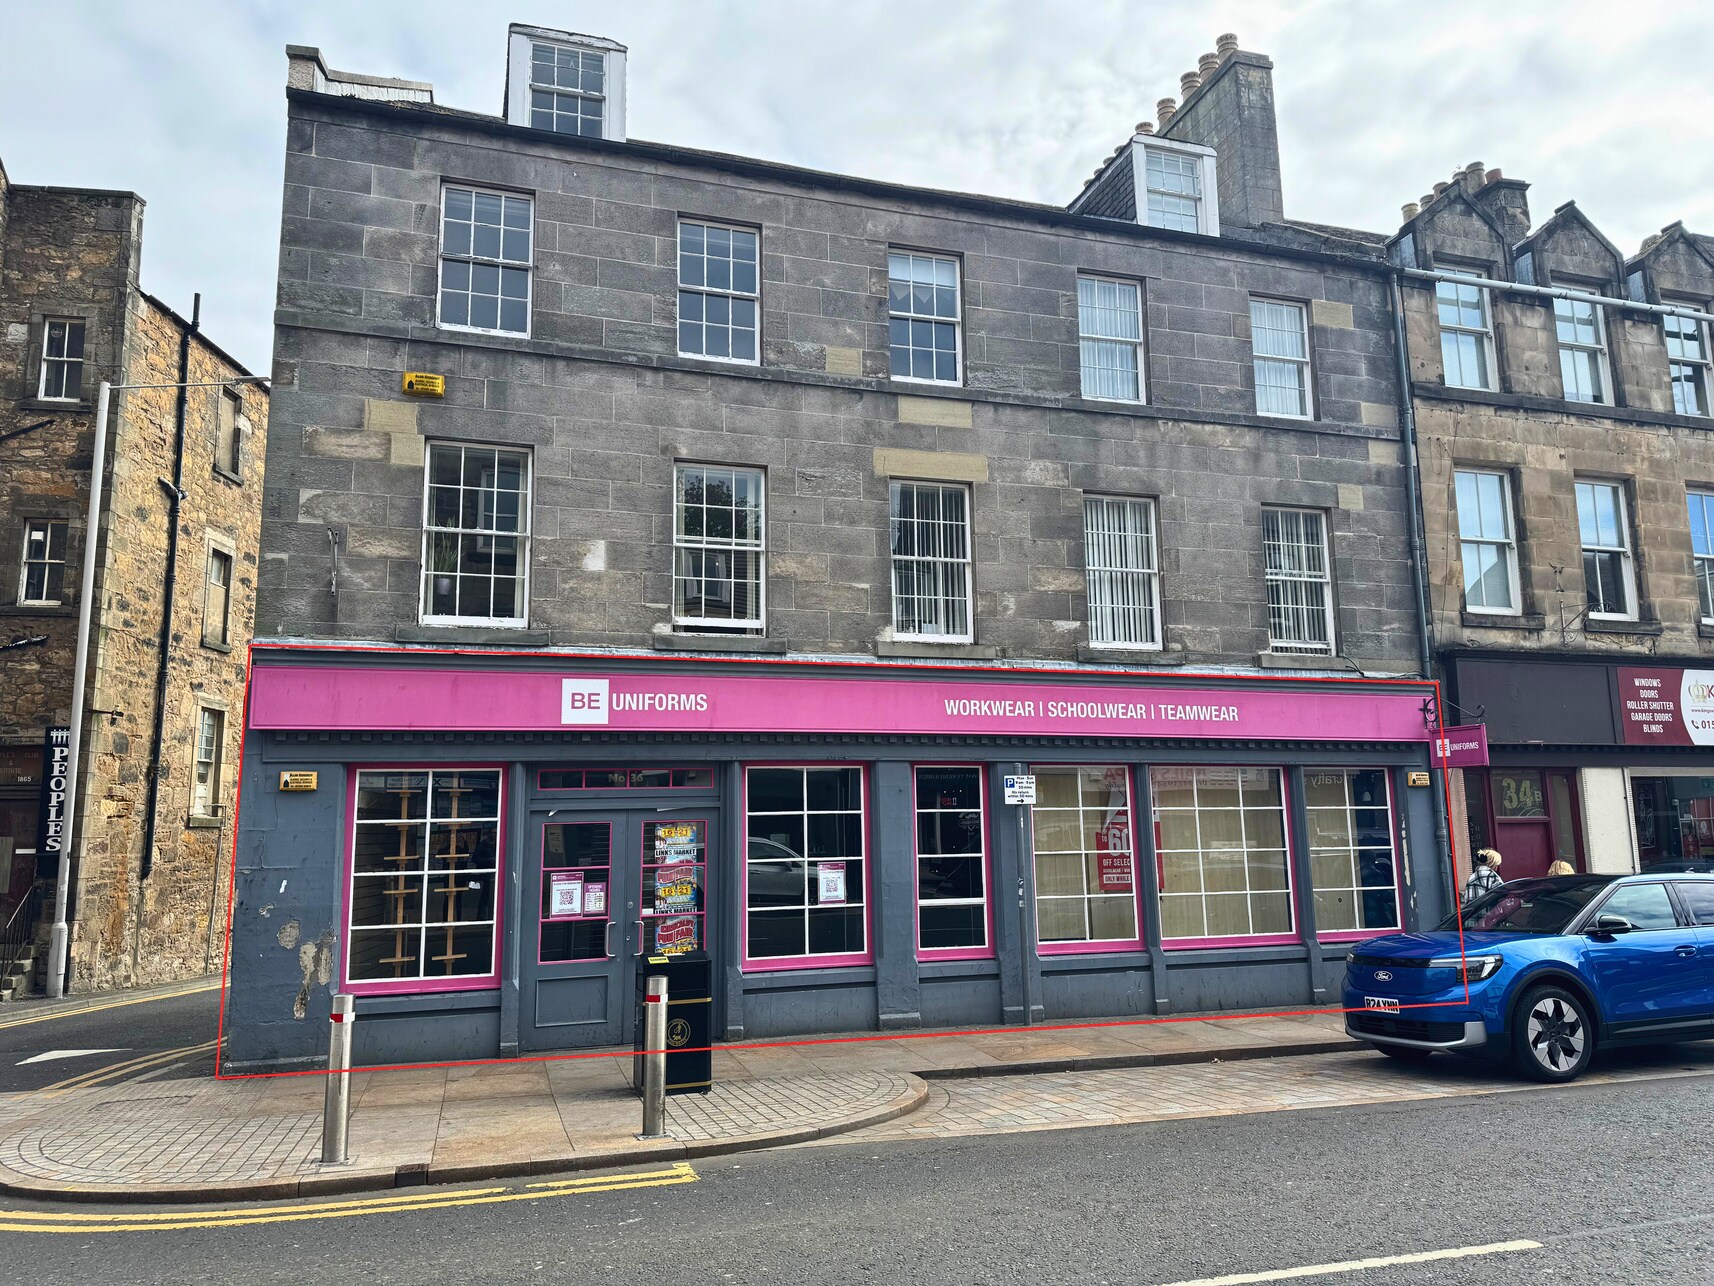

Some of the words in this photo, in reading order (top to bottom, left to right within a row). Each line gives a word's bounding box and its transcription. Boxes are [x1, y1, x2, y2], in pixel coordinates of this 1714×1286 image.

[1634, 678, 1662, 687] WINDOWS
[1640, 690, 1658, 698] DOORS
[571, 692, 600, 710] BE
[612, 693, 708, 711] UNIFORMS
[1626, 700, 1648, 710] ROLLER
[1649, 702, 1674, 710] SHUTTER
[944, 699, 1035, 717] WORKWEAR
[1048, 701, 1146, 720] SCHOOLWEAR
[1158, 704, 1239, 722] TEAMWEAR
[1630, 712, 1653, 721] GARAGE
[1654, 713, 1672, 722] DOORS
[1643, 724, 1664, 733] BLINDS
[1450, 742, 1479, 751] UNIFORMS
[608, 774, 625, 782] No
[630, 774, 644, 782] 36
[1502, 778, 1532, 808] 34
[1535, 790, 1542, 801] B
[45, 747, 69, 851] PEOPLES
[658, 932, 674, 943] FUN
[676, 928, 694, 939] FAIR
